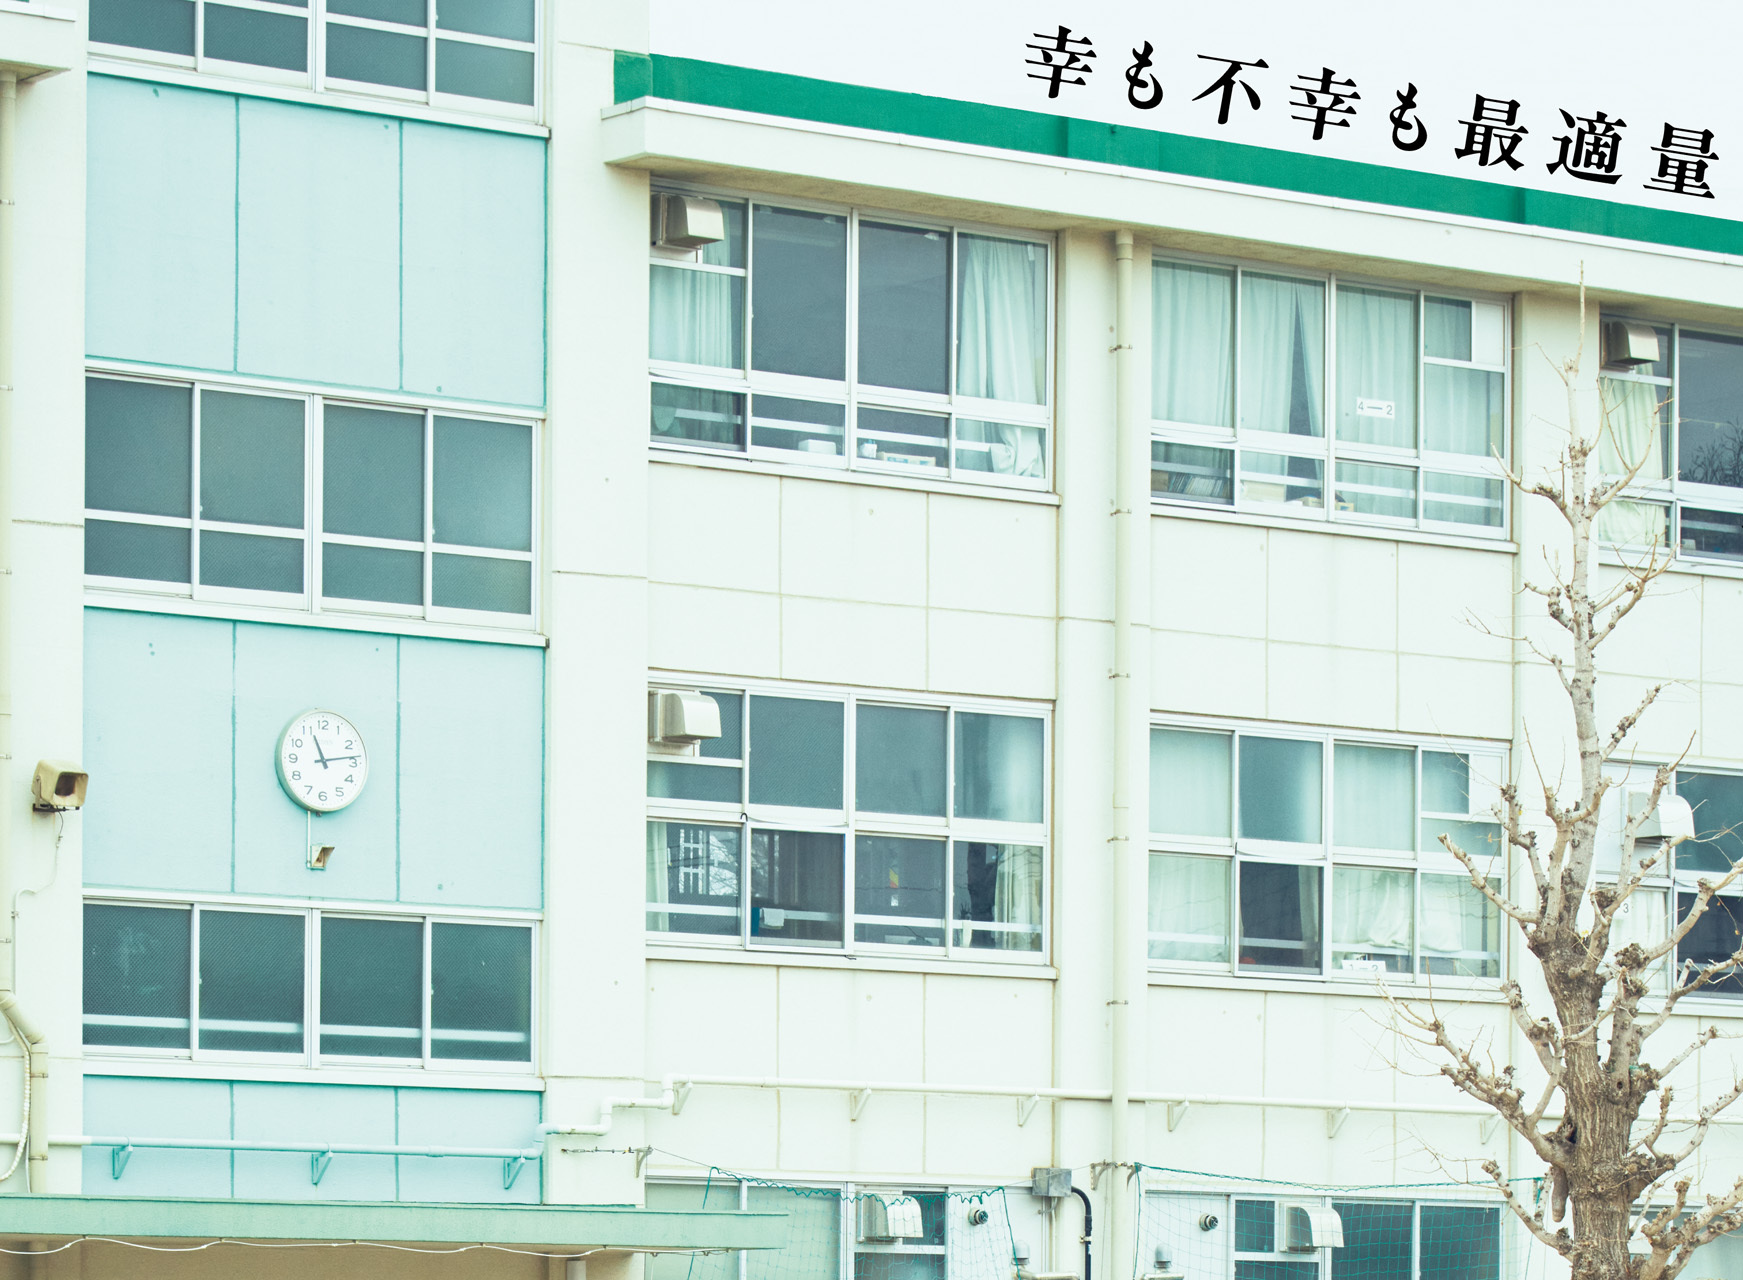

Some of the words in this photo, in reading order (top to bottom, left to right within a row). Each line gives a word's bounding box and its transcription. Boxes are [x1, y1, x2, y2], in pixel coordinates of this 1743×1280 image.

[302, 725, 312, 735] 11
[318, 720, 329, 730] 12
[291, 738, 303, 748] 10
[344, 740, 353, 750] 2
[288, 753, 298, 763] 9
[348, 757, 358, 768] 3
[291, 771, 301, 780] 8
[344, 774, 354, 783] 4
[304, 785, 313, 795] 7
[335, 787, 345, 797] 5
[318, 791, 328, 801] 6
